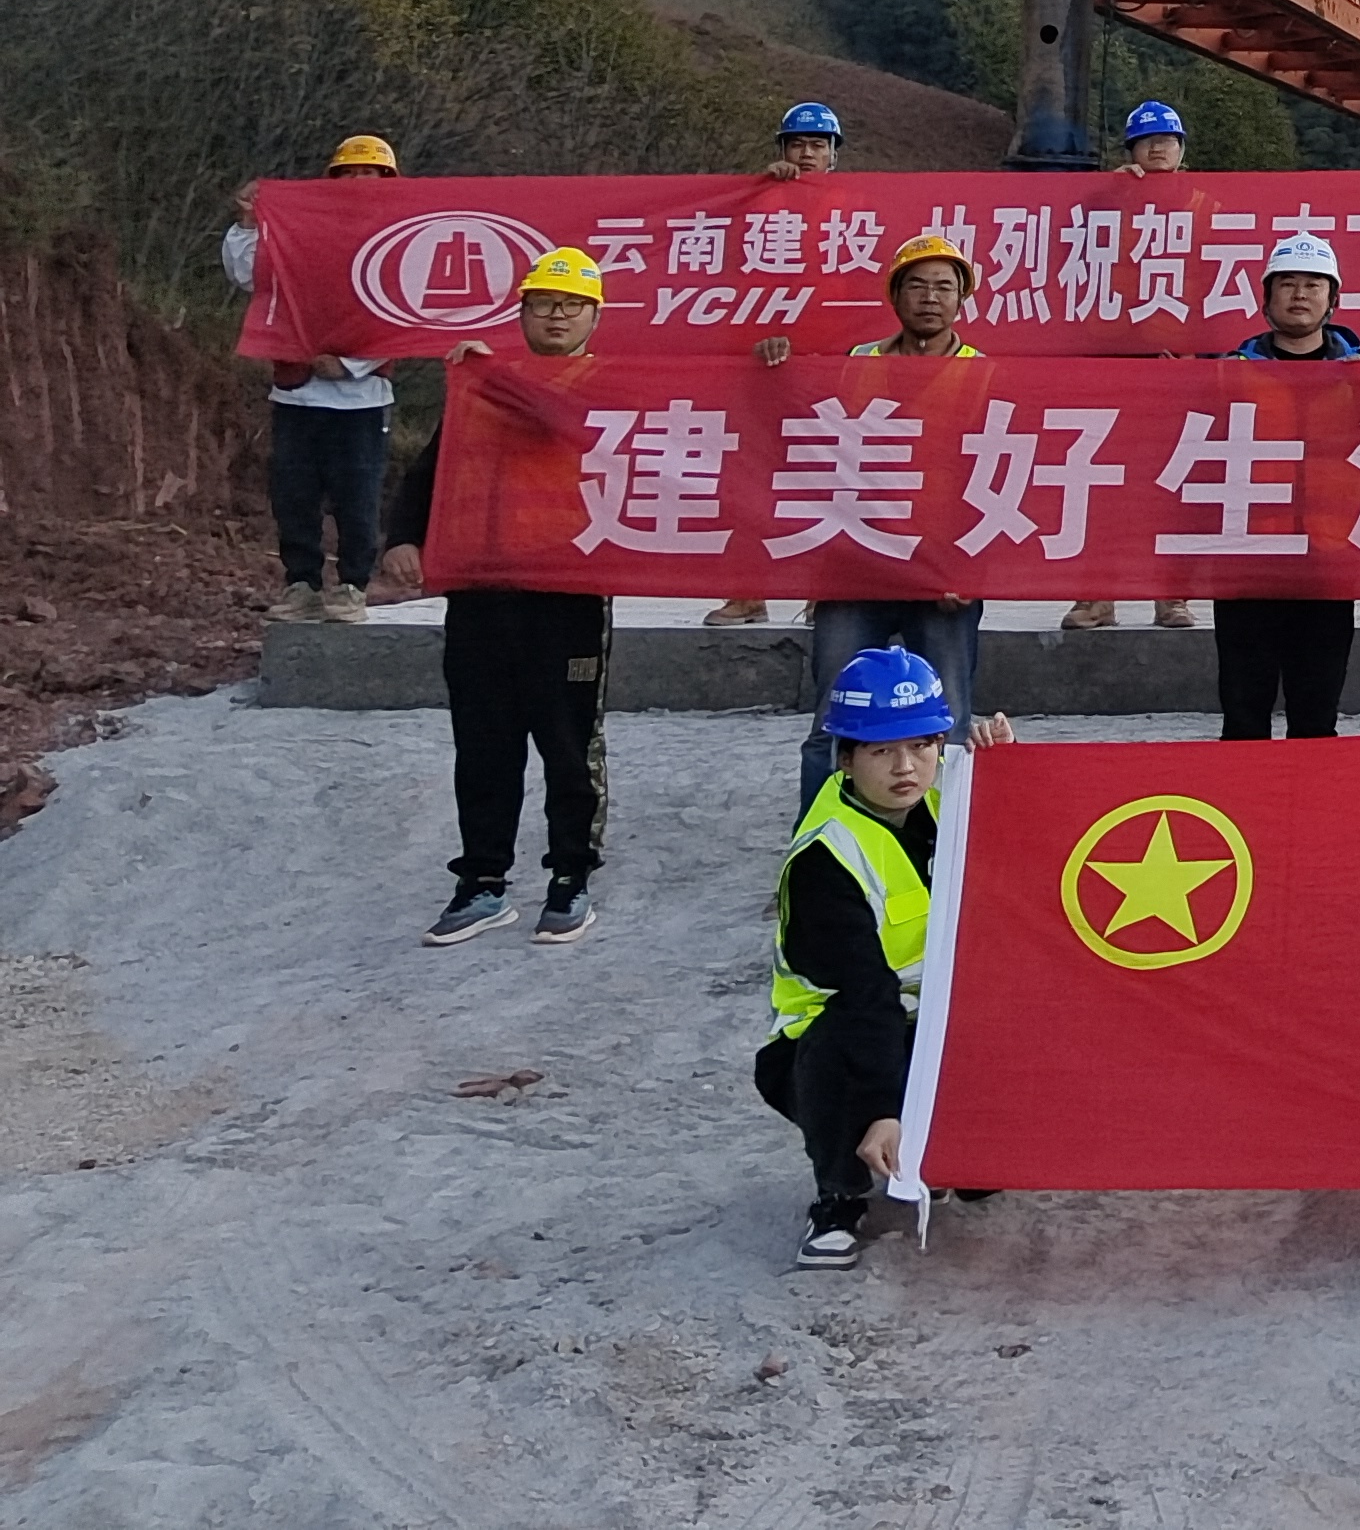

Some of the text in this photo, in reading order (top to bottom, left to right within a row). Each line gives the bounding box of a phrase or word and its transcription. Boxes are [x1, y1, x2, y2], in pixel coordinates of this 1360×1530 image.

[586, 209, 885, 276] 云南建投
[650, 286, 815, 326] YCIH
